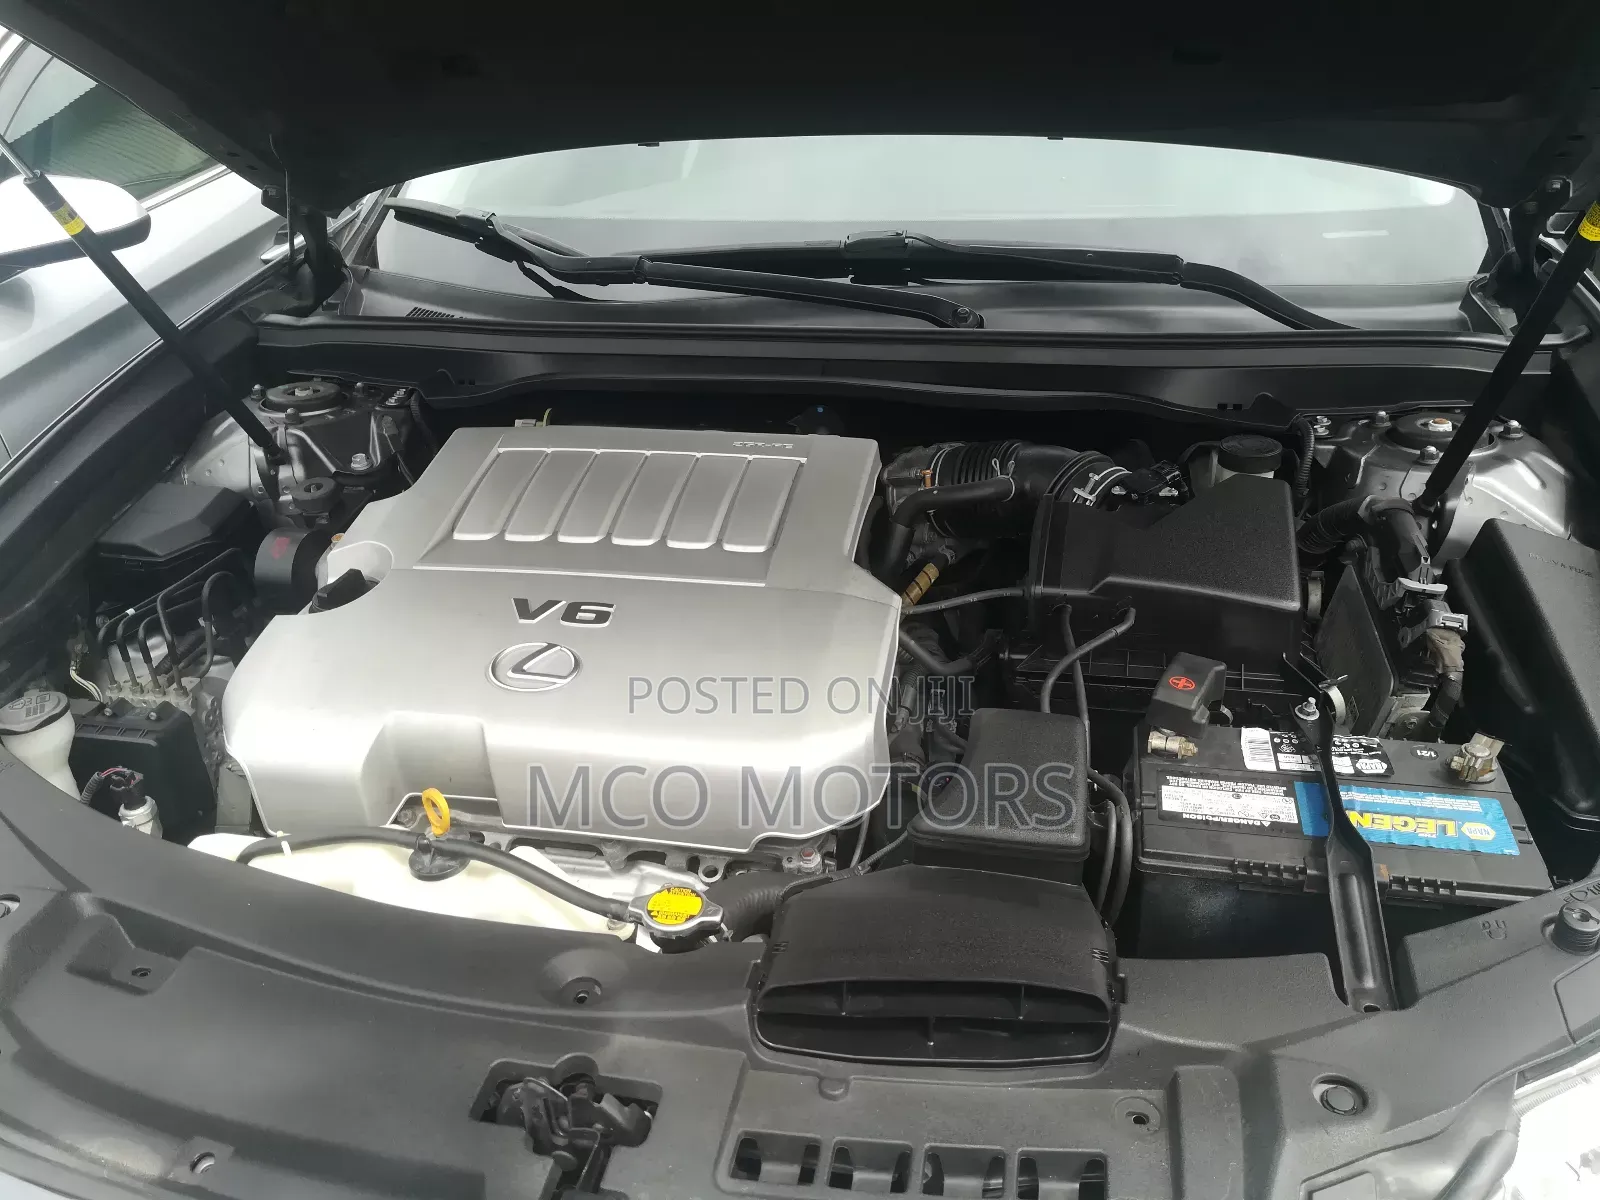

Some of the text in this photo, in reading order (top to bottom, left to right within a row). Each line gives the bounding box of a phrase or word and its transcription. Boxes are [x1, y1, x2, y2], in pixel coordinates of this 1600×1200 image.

[511, 597, 617, 628] V6
[1346, 809, 1459, 838] LEGEN
[1467, 826, 1491, 837] NAPA
